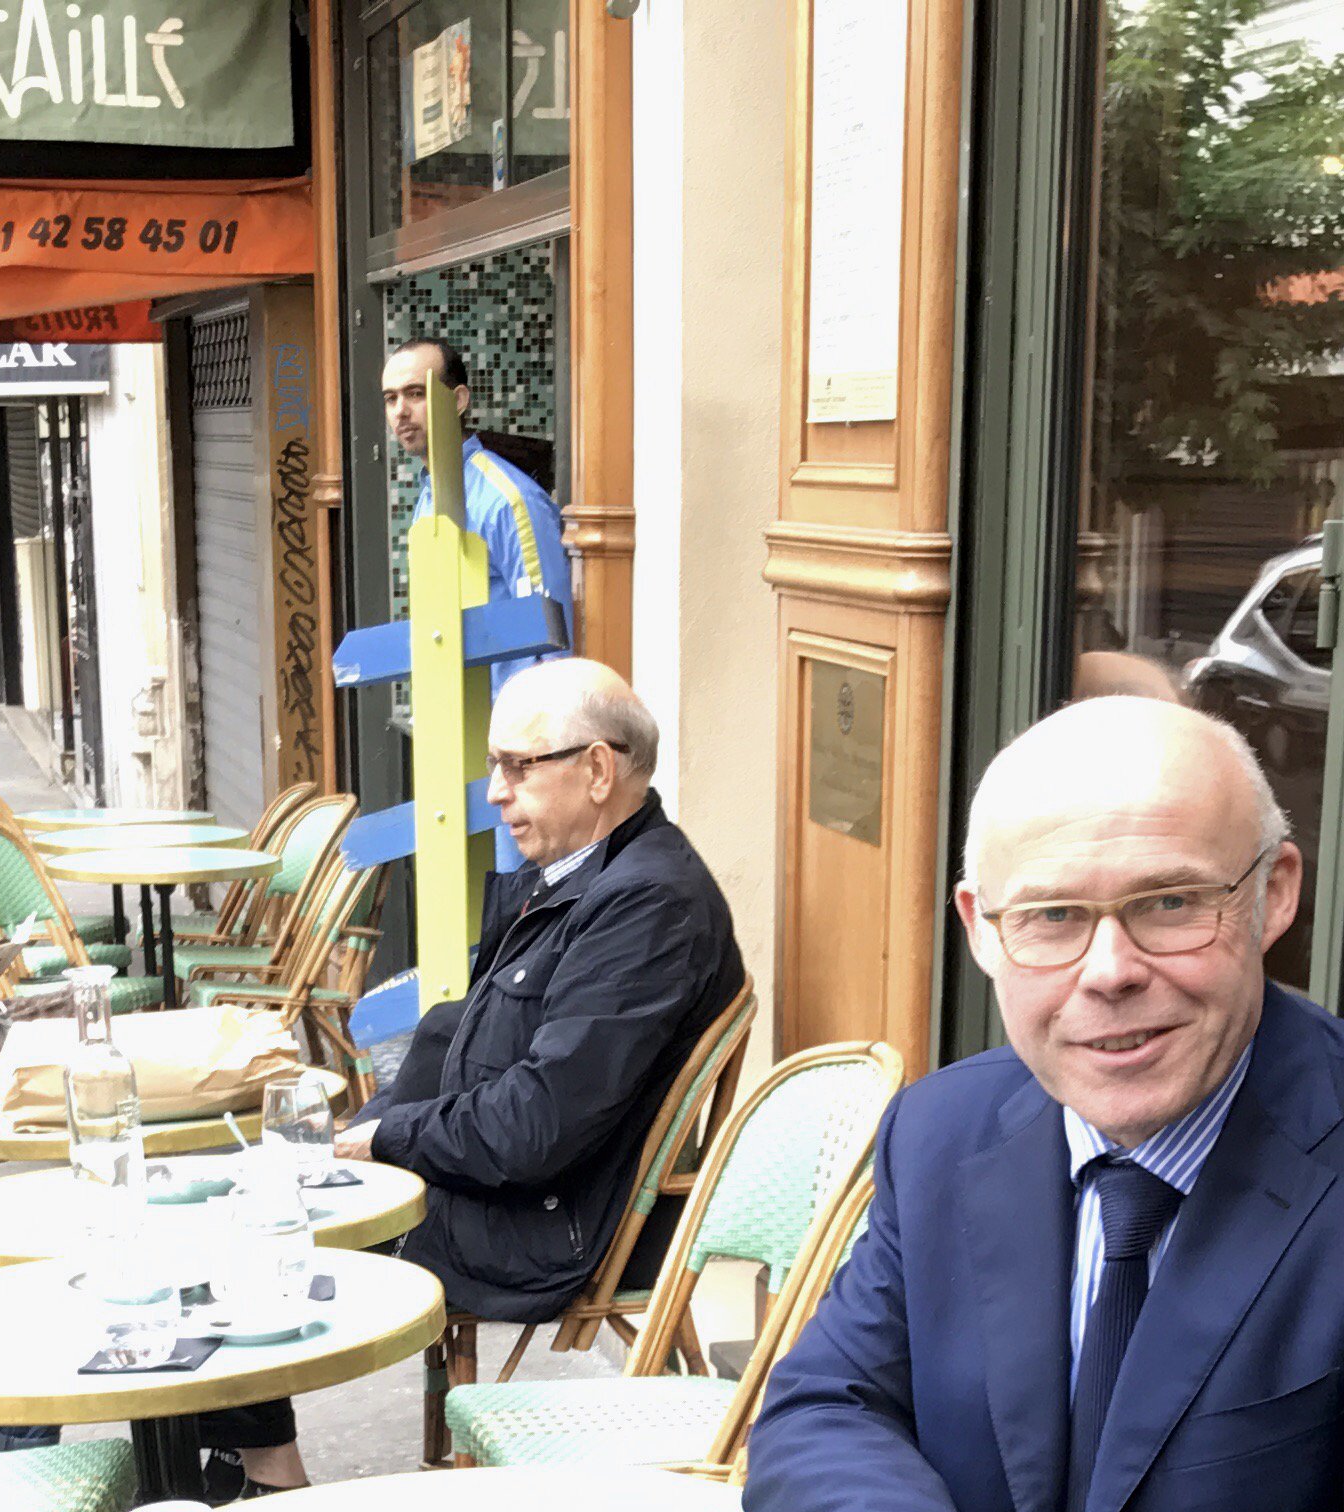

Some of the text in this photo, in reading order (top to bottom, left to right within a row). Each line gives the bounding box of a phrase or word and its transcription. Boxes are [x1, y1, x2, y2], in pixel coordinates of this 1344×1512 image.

[27, 214, 72, 249] 42
[81, 216, 128, 251] 58
[139, 218, 186, 253] 45
[199, 219, 239, 254] 01
